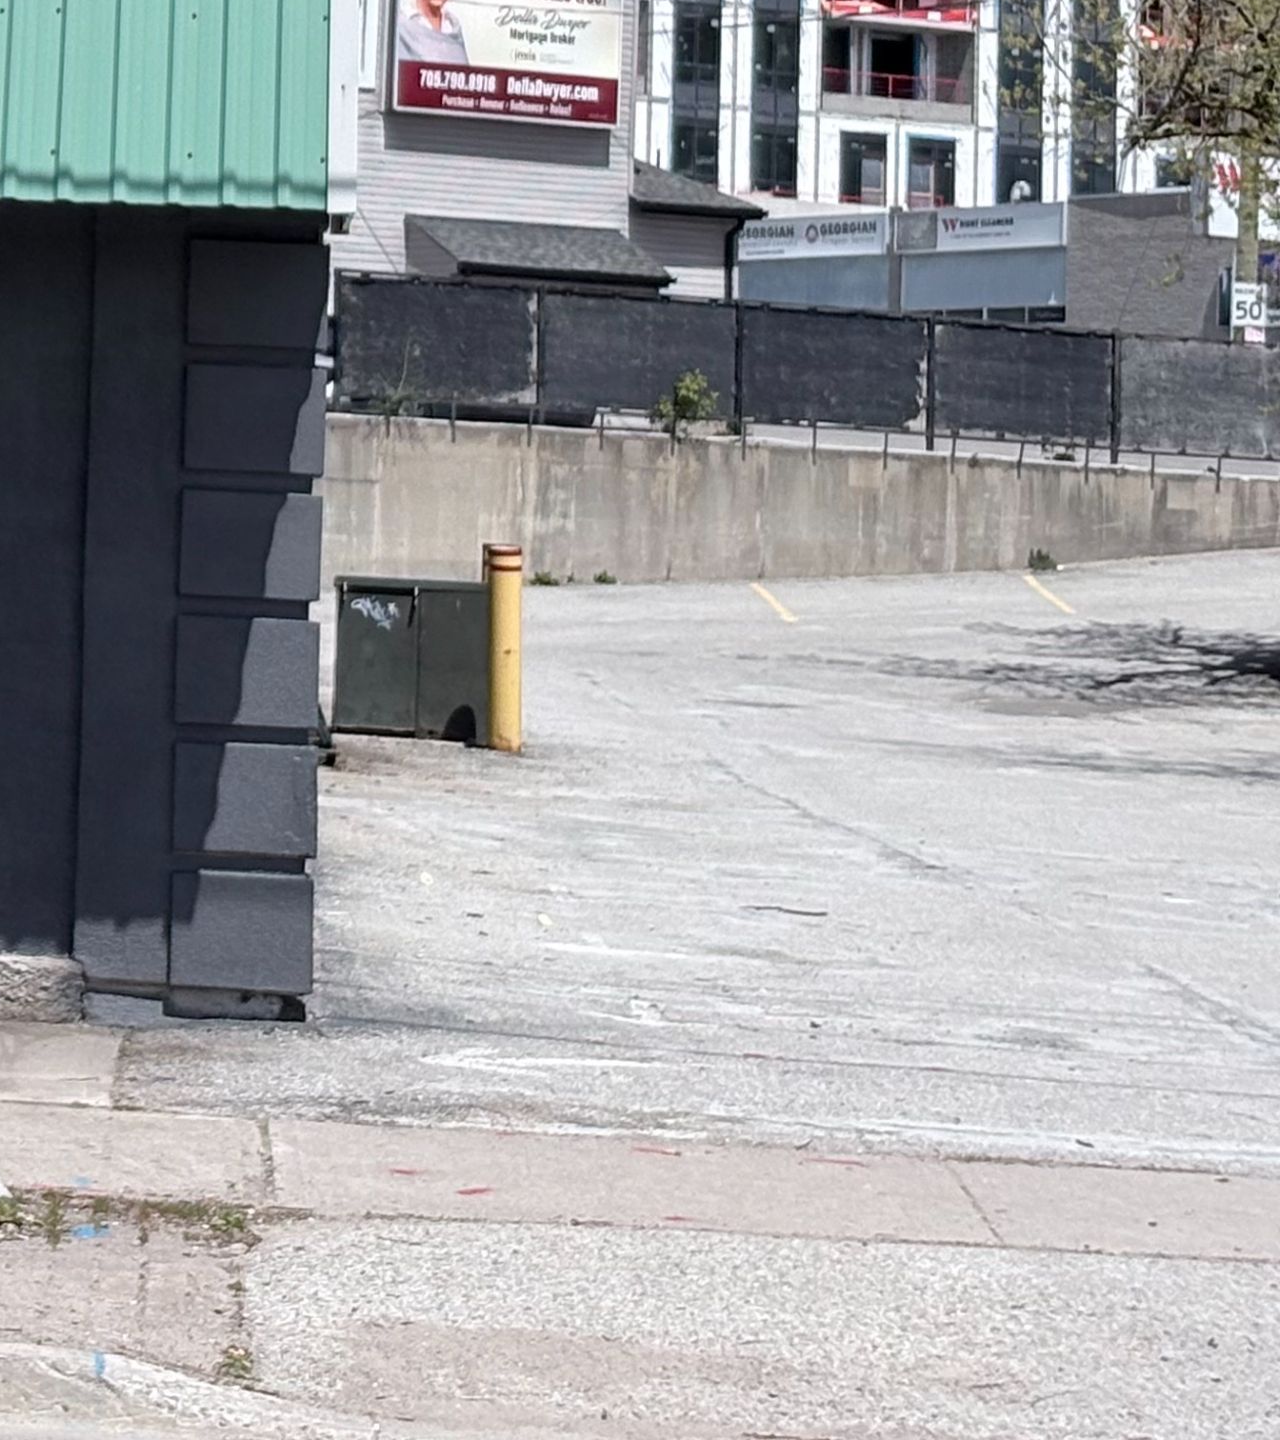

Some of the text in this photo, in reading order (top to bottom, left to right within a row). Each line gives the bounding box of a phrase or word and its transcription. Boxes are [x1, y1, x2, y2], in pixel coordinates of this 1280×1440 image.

[494, 5, 592, 34] Della Dwyer
[509, 27, 576, 46] Mortgage Broker
[506, 75, 599, 103] DellaDwyer.com
[819, 220, 877, 236] GEORGIAN
[1235, 300, 1262, 320] 50
